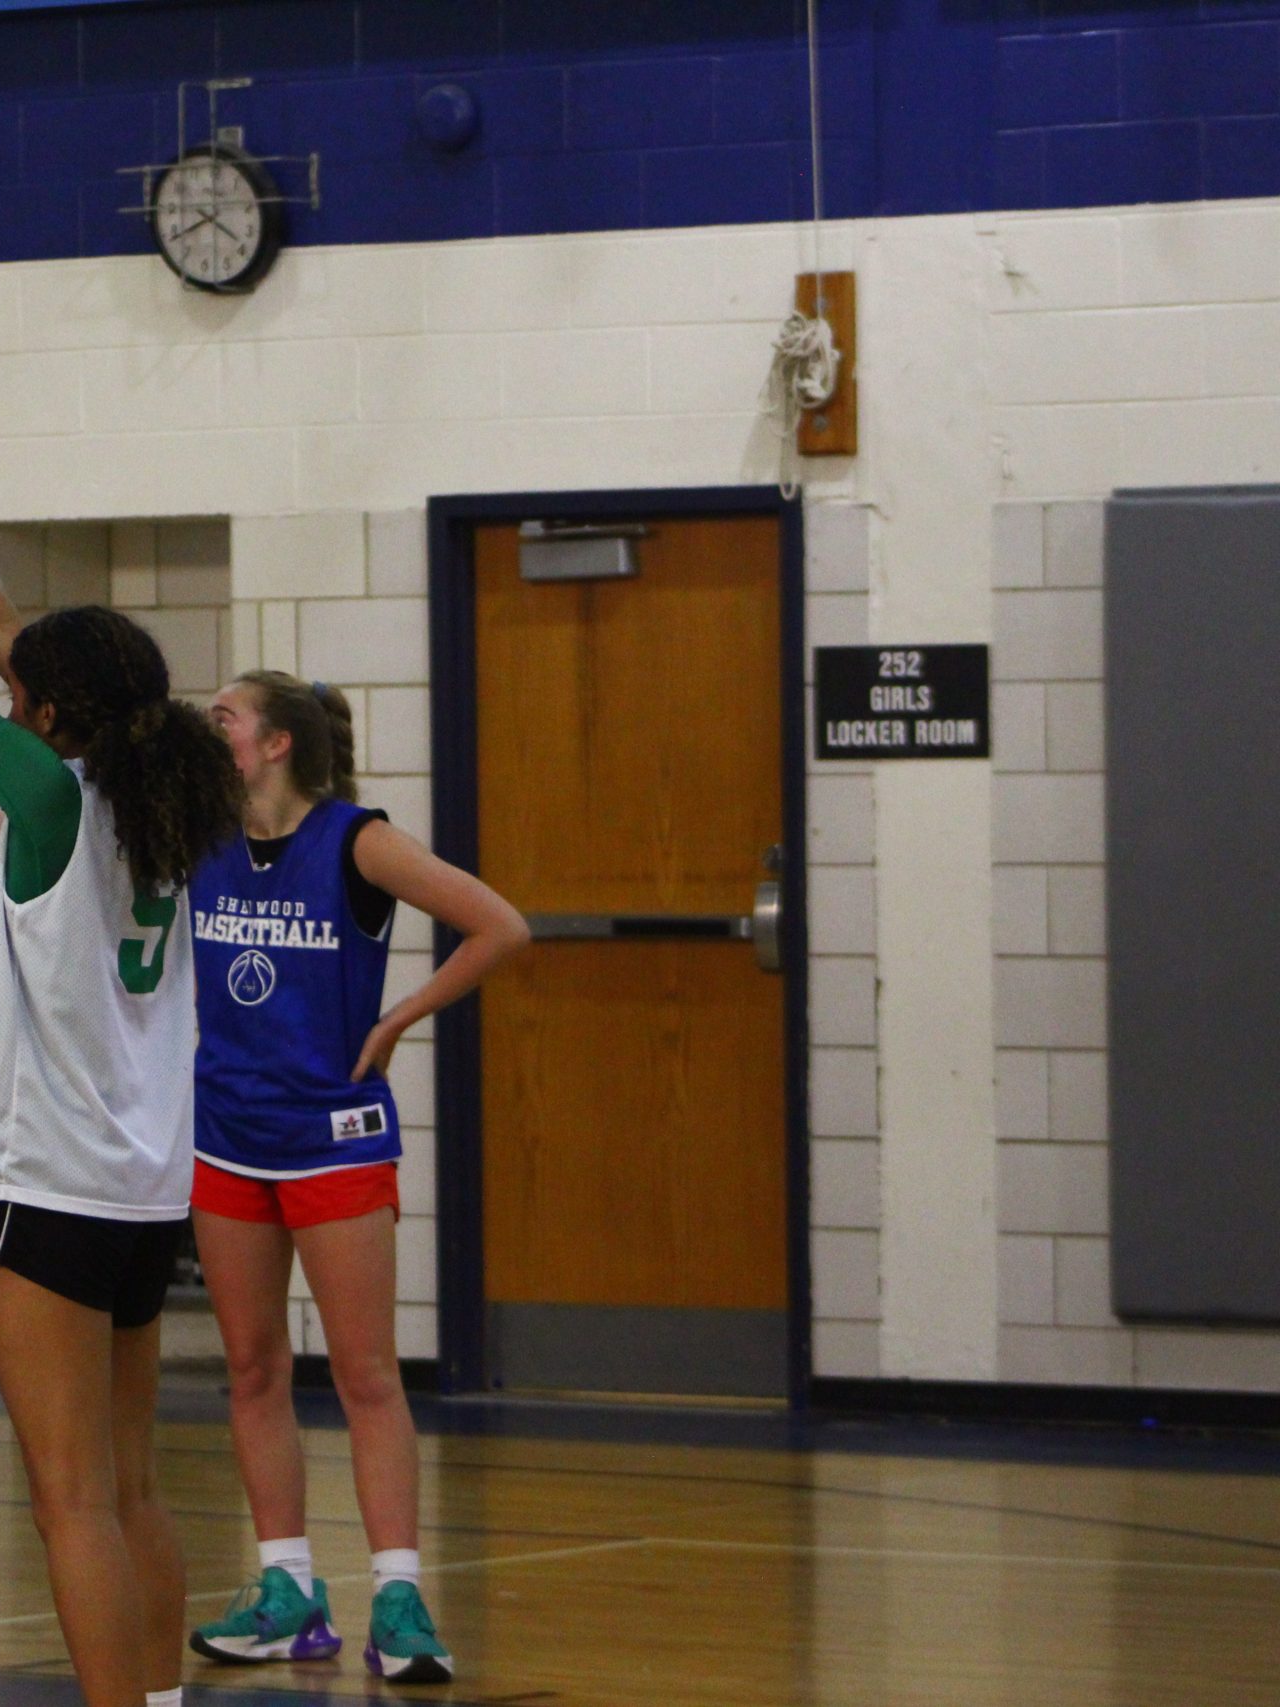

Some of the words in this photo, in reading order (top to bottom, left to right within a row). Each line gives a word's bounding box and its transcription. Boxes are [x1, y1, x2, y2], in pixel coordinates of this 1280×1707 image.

[878, 651, 921, 678] 252
[870, 685, 932, 713] GIRLS
[826, 719, 906, 746] LOCKER
[914, 719, 976, 745] ROOM
[216, 895, 306, 917] SHEWOOD
